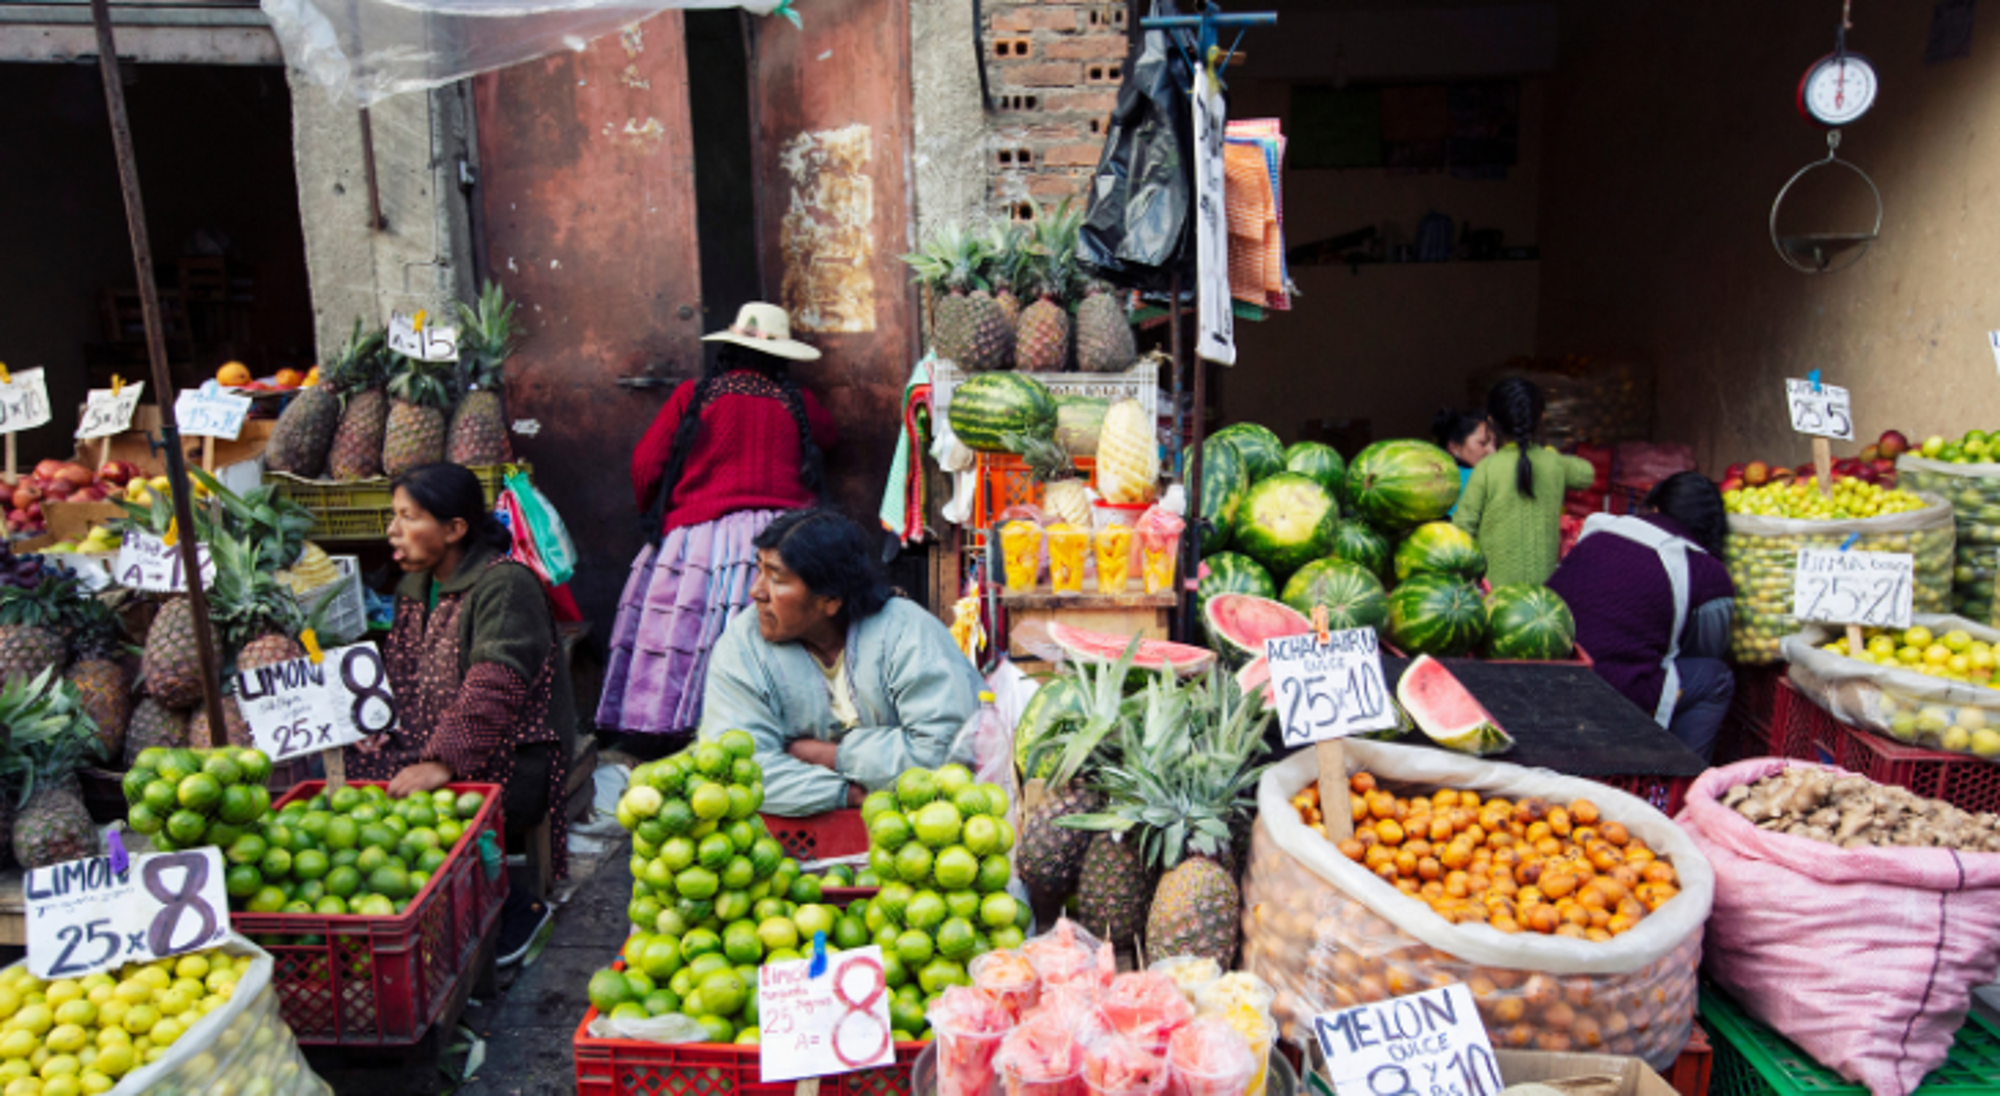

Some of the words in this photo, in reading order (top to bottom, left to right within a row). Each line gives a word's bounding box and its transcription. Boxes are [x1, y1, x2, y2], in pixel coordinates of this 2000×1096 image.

[1827, 402, 1850, 436] 5
[340, 646, 398, 736] 8
[142, 852, 217, 958] 8
[831, 955, 889, 1069] 8
[1314, 987, 1459, 1057] MELON
